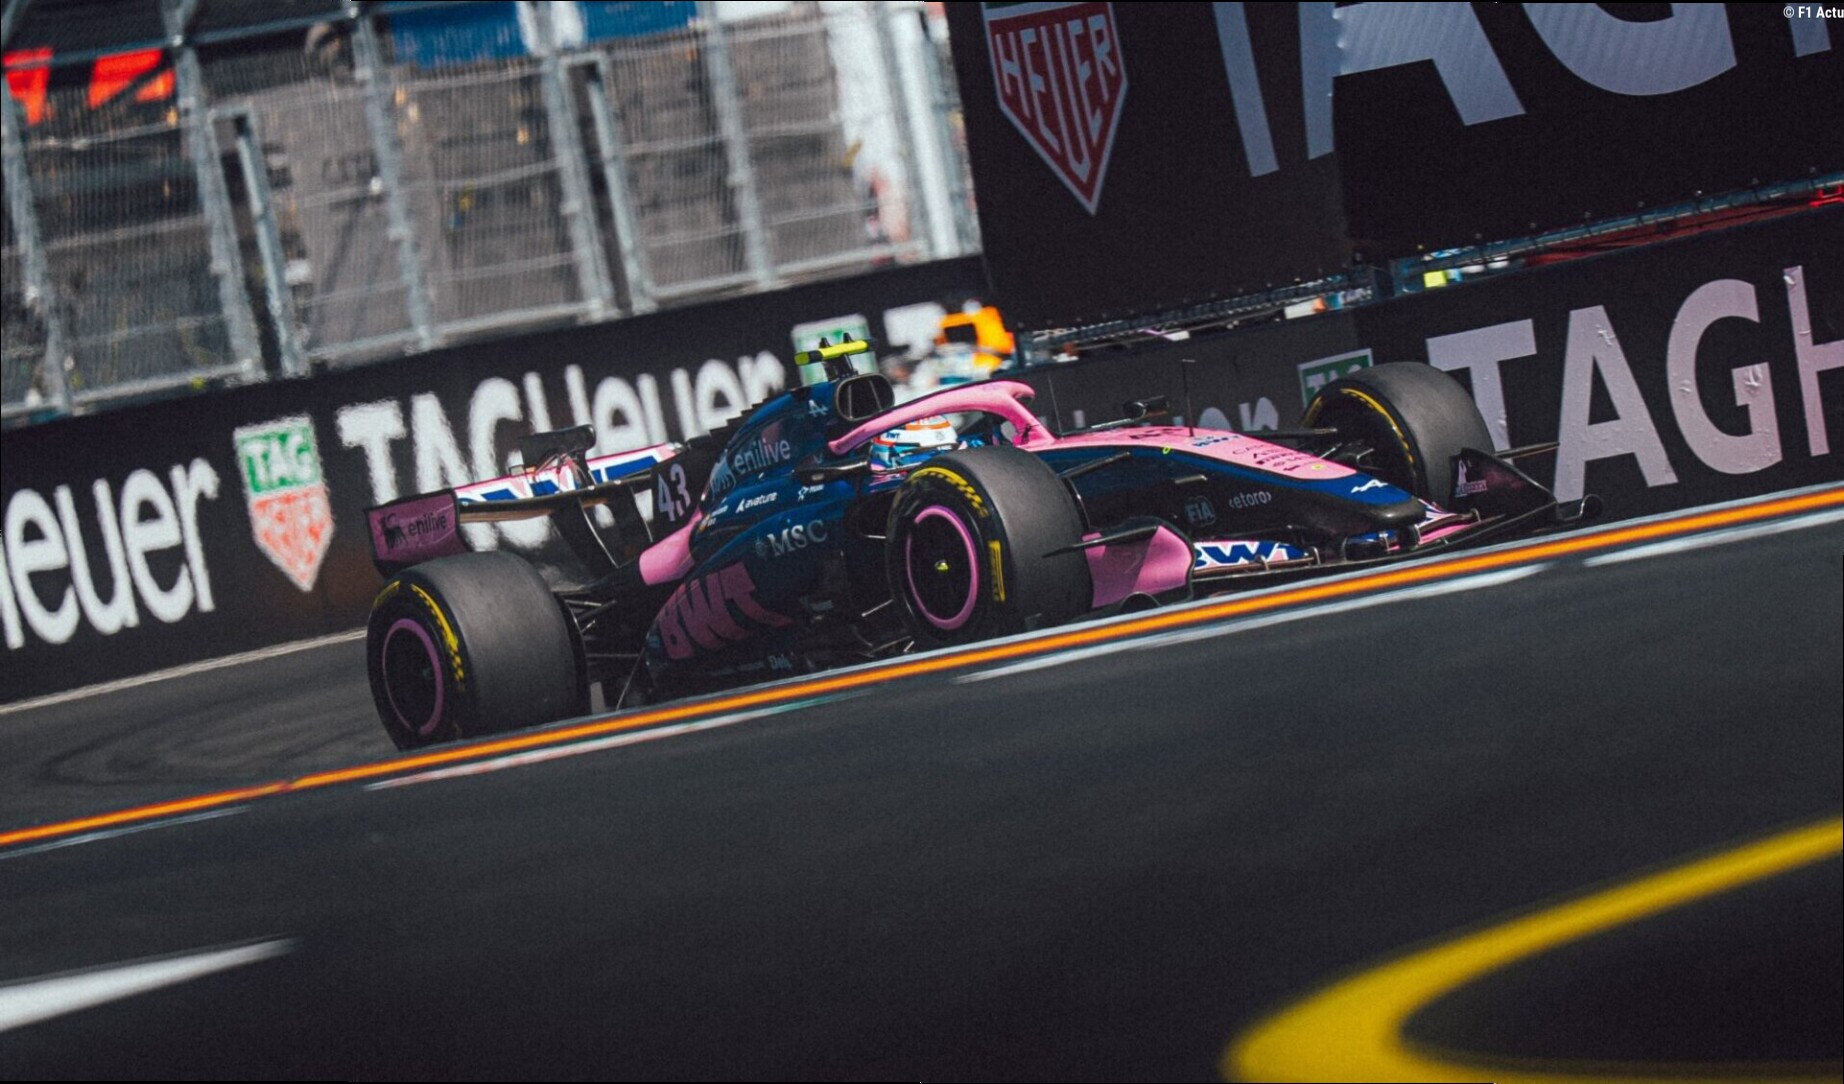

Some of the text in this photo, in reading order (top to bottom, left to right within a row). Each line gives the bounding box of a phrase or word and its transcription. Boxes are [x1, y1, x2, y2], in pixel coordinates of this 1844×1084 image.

[995, 14, 1116, 184] HEUER
[247, 433, 313, 485] TAG
[734, 437, 792, 474] enilive
[657, 463, 692, 523] 43
[1186, 506, 1215, 524] FIA
[408, 509, 447, 538] enilive
[766, 519, 828, 557] MSC
[0, 457, 220, 650] euer
